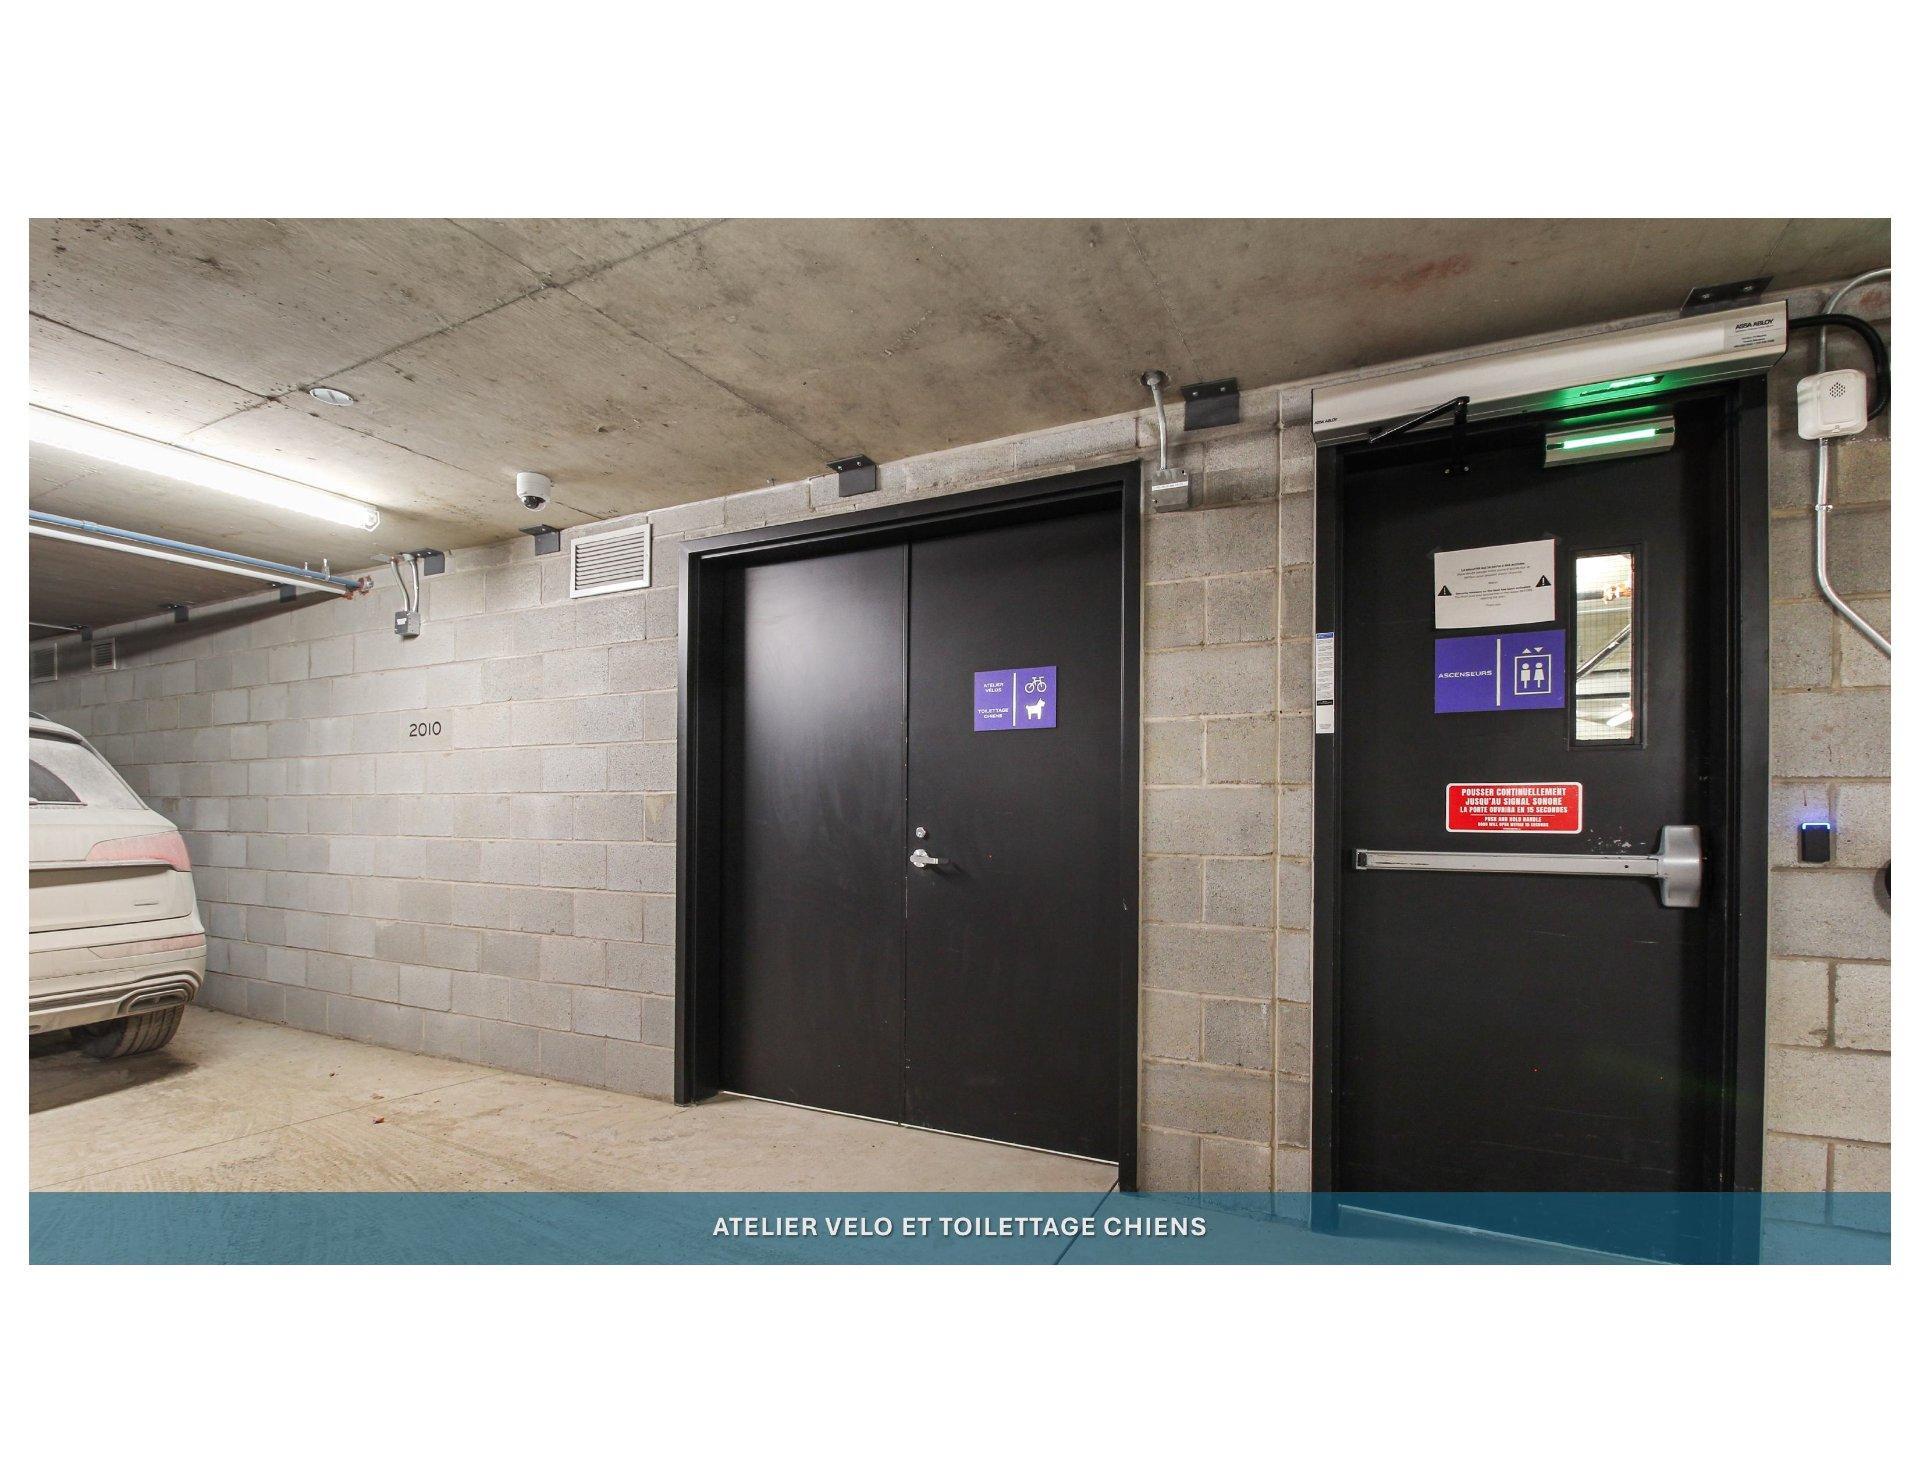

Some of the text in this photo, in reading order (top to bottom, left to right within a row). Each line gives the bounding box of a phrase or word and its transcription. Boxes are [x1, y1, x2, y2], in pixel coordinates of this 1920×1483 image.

[1438, 670, 1493, 679] ASCENSEURS
[409, 721, 442, 737] 2010
[1461, 788, 1567, 797] POUSSER CONTINUELLEMENT
[1465, 797, 1562, 806] JUSQU'AU SIGNAL SONORE
